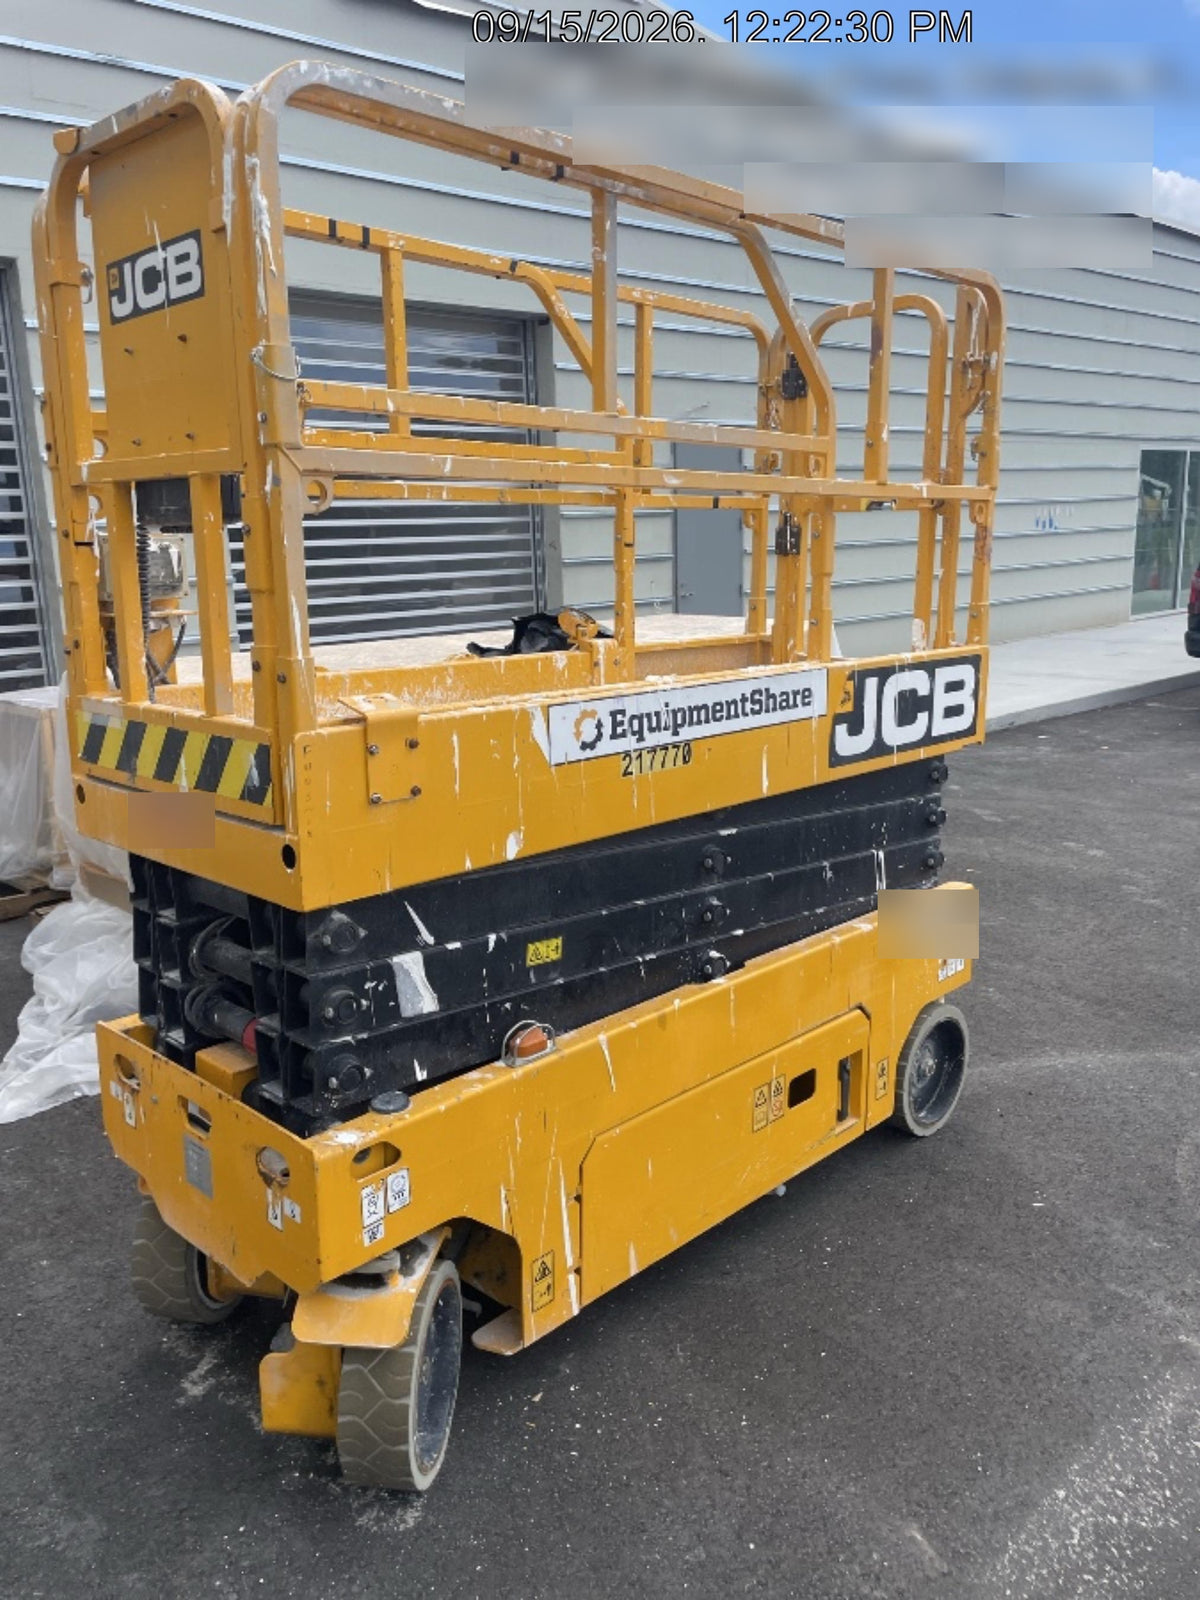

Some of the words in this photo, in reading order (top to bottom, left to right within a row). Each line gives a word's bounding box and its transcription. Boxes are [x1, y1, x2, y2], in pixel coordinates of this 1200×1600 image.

[111, 237, 202, 318] JCB
[609, 687, 812, 743] EquipmentShare
[834, 664, 976, 757] JCB
[621, 742, 692, 777] 217770
